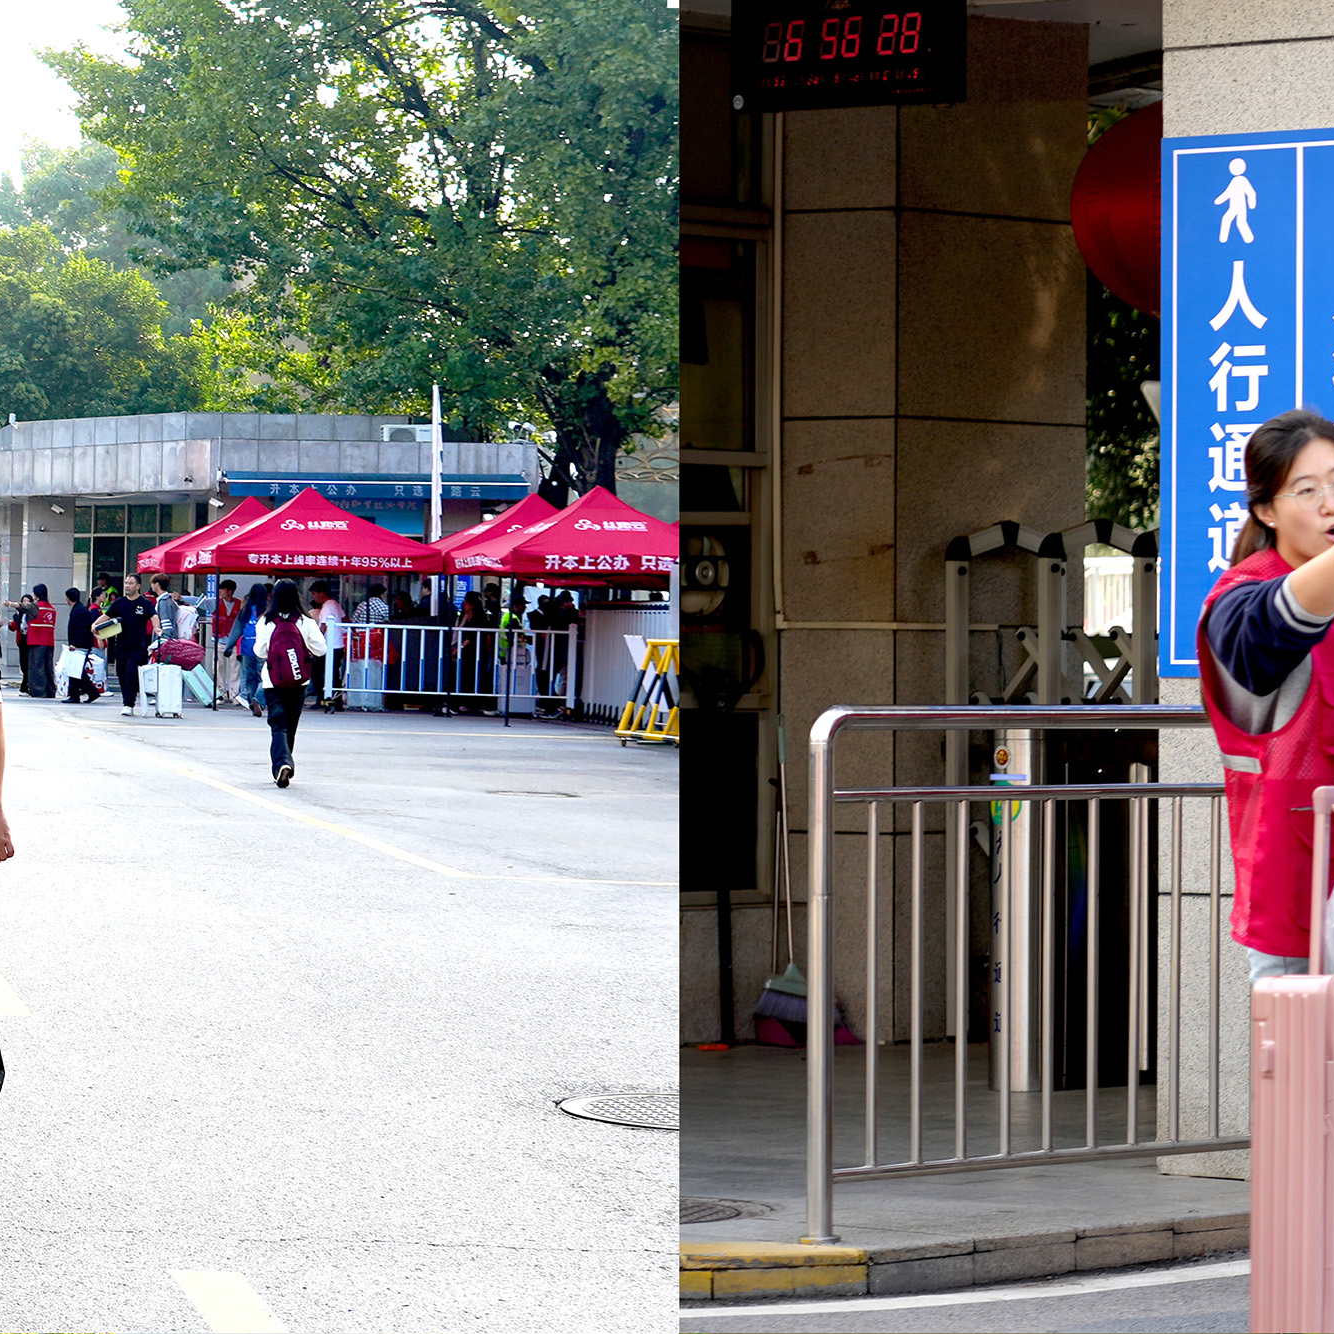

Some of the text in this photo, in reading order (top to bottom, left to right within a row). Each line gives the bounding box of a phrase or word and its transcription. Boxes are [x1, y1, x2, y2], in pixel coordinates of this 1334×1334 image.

[269, 483, 482, 498] 升本公办 只选路云
[248, 552, 413, 569] 专升本上线率连续十年95%以上
[545, 555, 630, 571] 升本上公办
